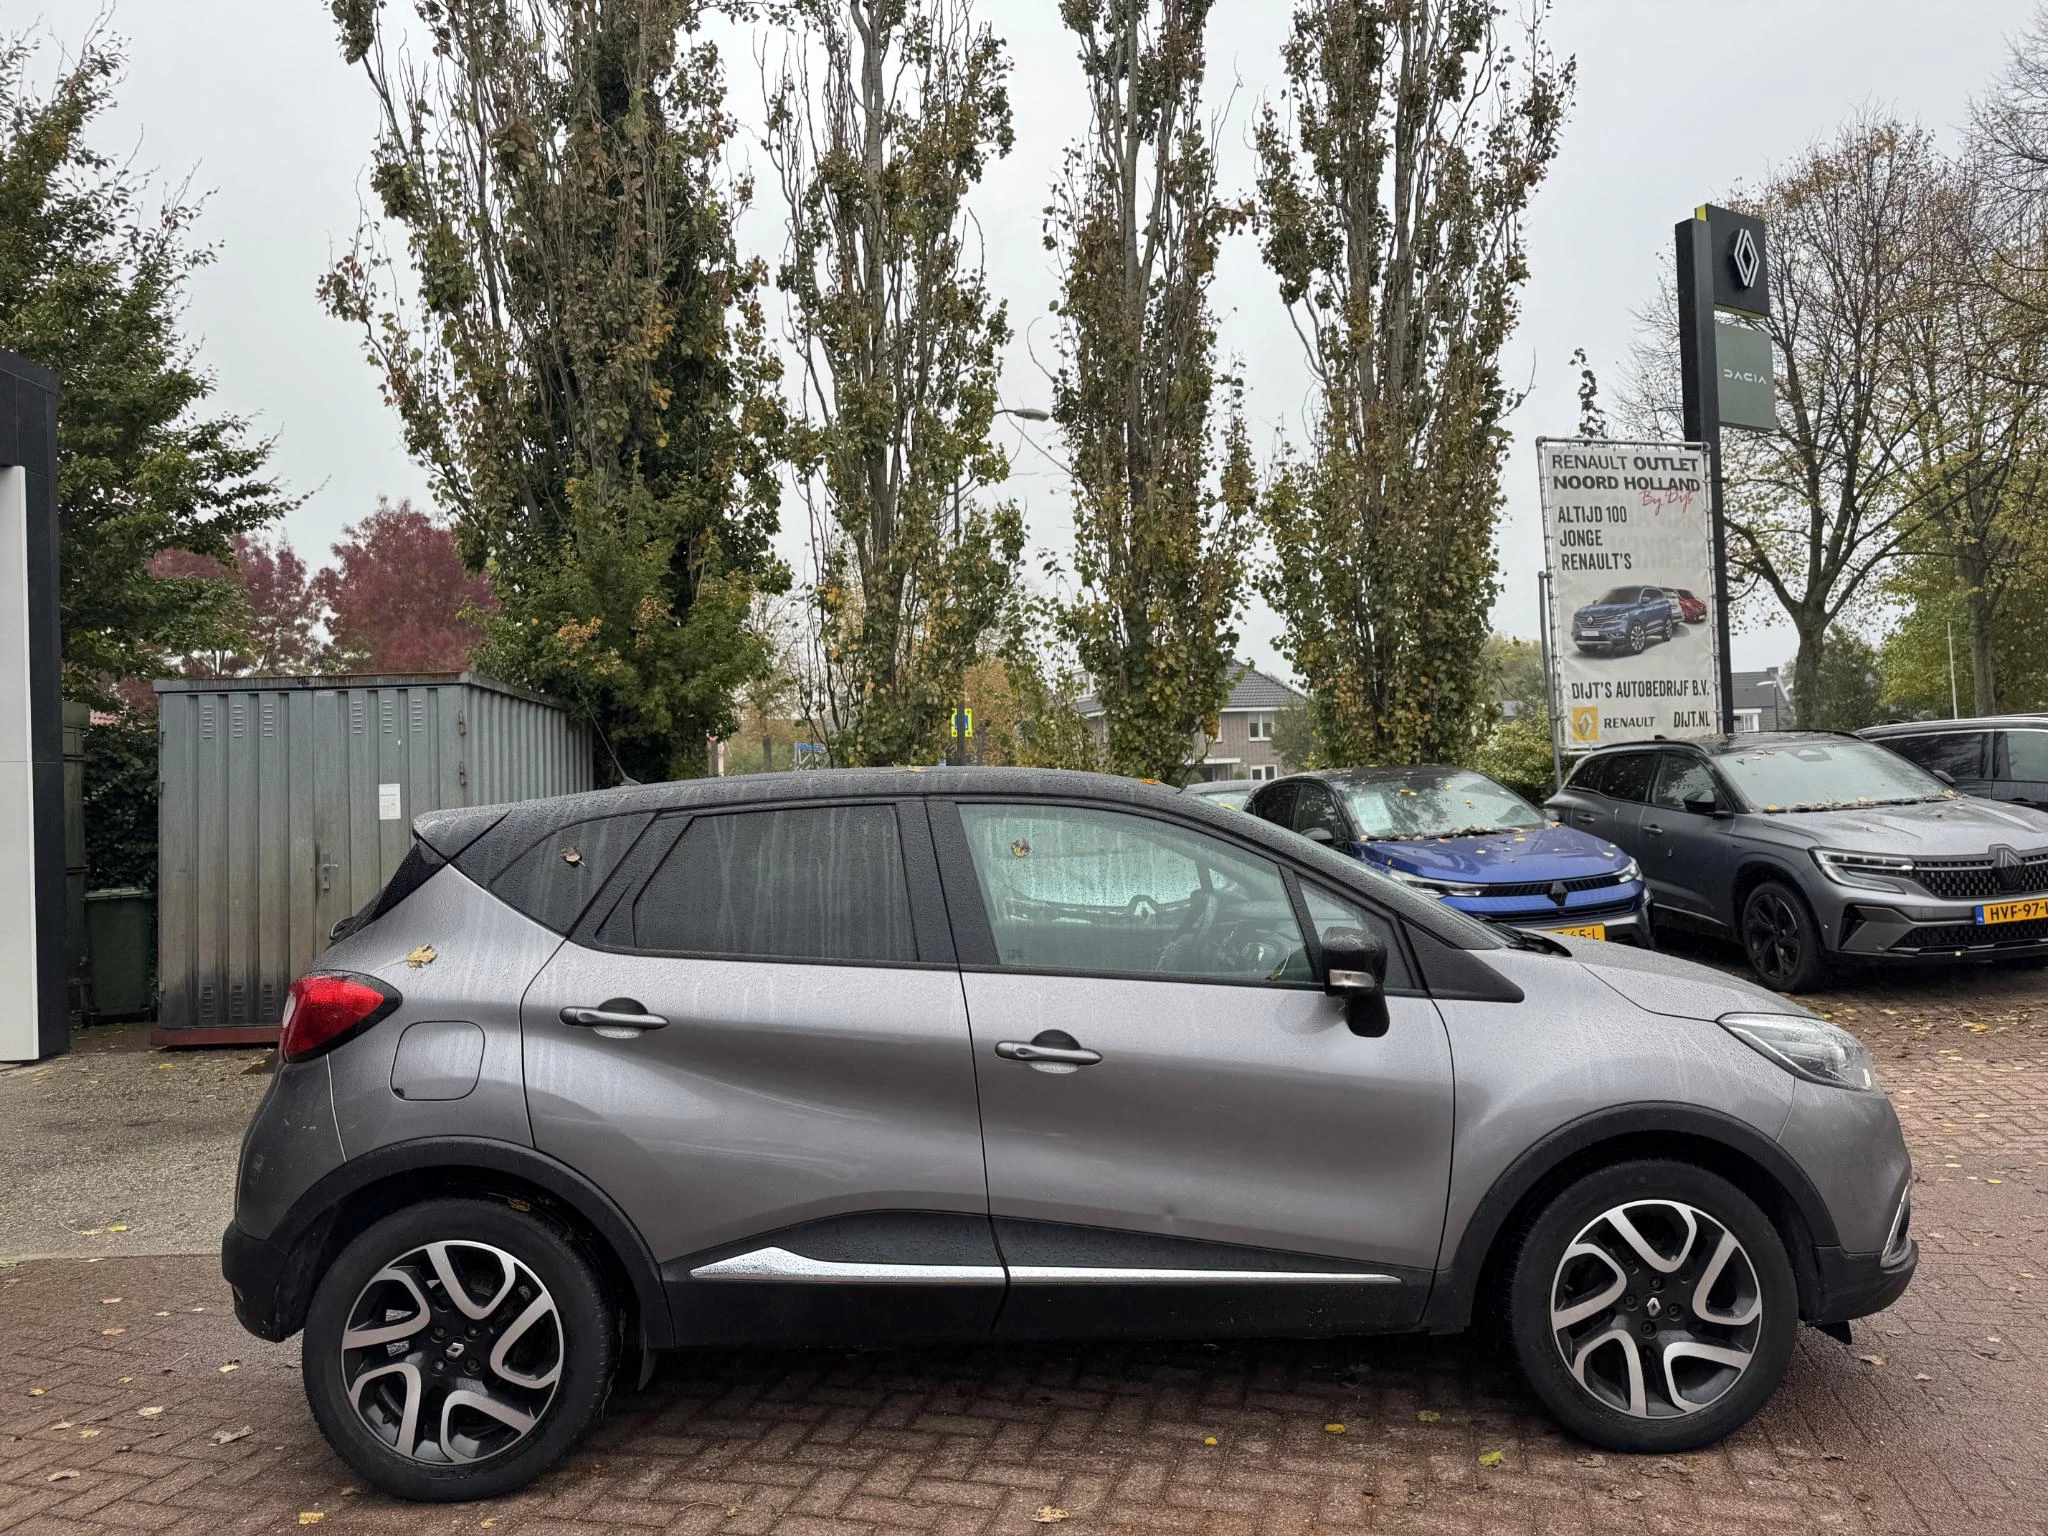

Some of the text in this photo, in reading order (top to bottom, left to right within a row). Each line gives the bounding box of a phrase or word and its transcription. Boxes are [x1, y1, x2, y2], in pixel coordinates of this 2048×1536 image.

[1723, 368, 1767, 385] DACIA
[1552, 455, 1698, 472] RENAULT OUTLET
[1554, 475, 1700, 492] NOORD HOLLAND
[1639, 490, 1663, 516] By
[1558, 505, 1627, 523] ALTIJD 100
[1560, 530, 1603, 547] JONGE
[1561, 553, 1632, 571] RENAULT'S
[1571, 680, 1710, 699] DIJT'S AUTOBEDRIJF B.V.
[1604, 716, 1656, 729] RENAULT
[1673, 711, 1710, 728] DIJT.NL
